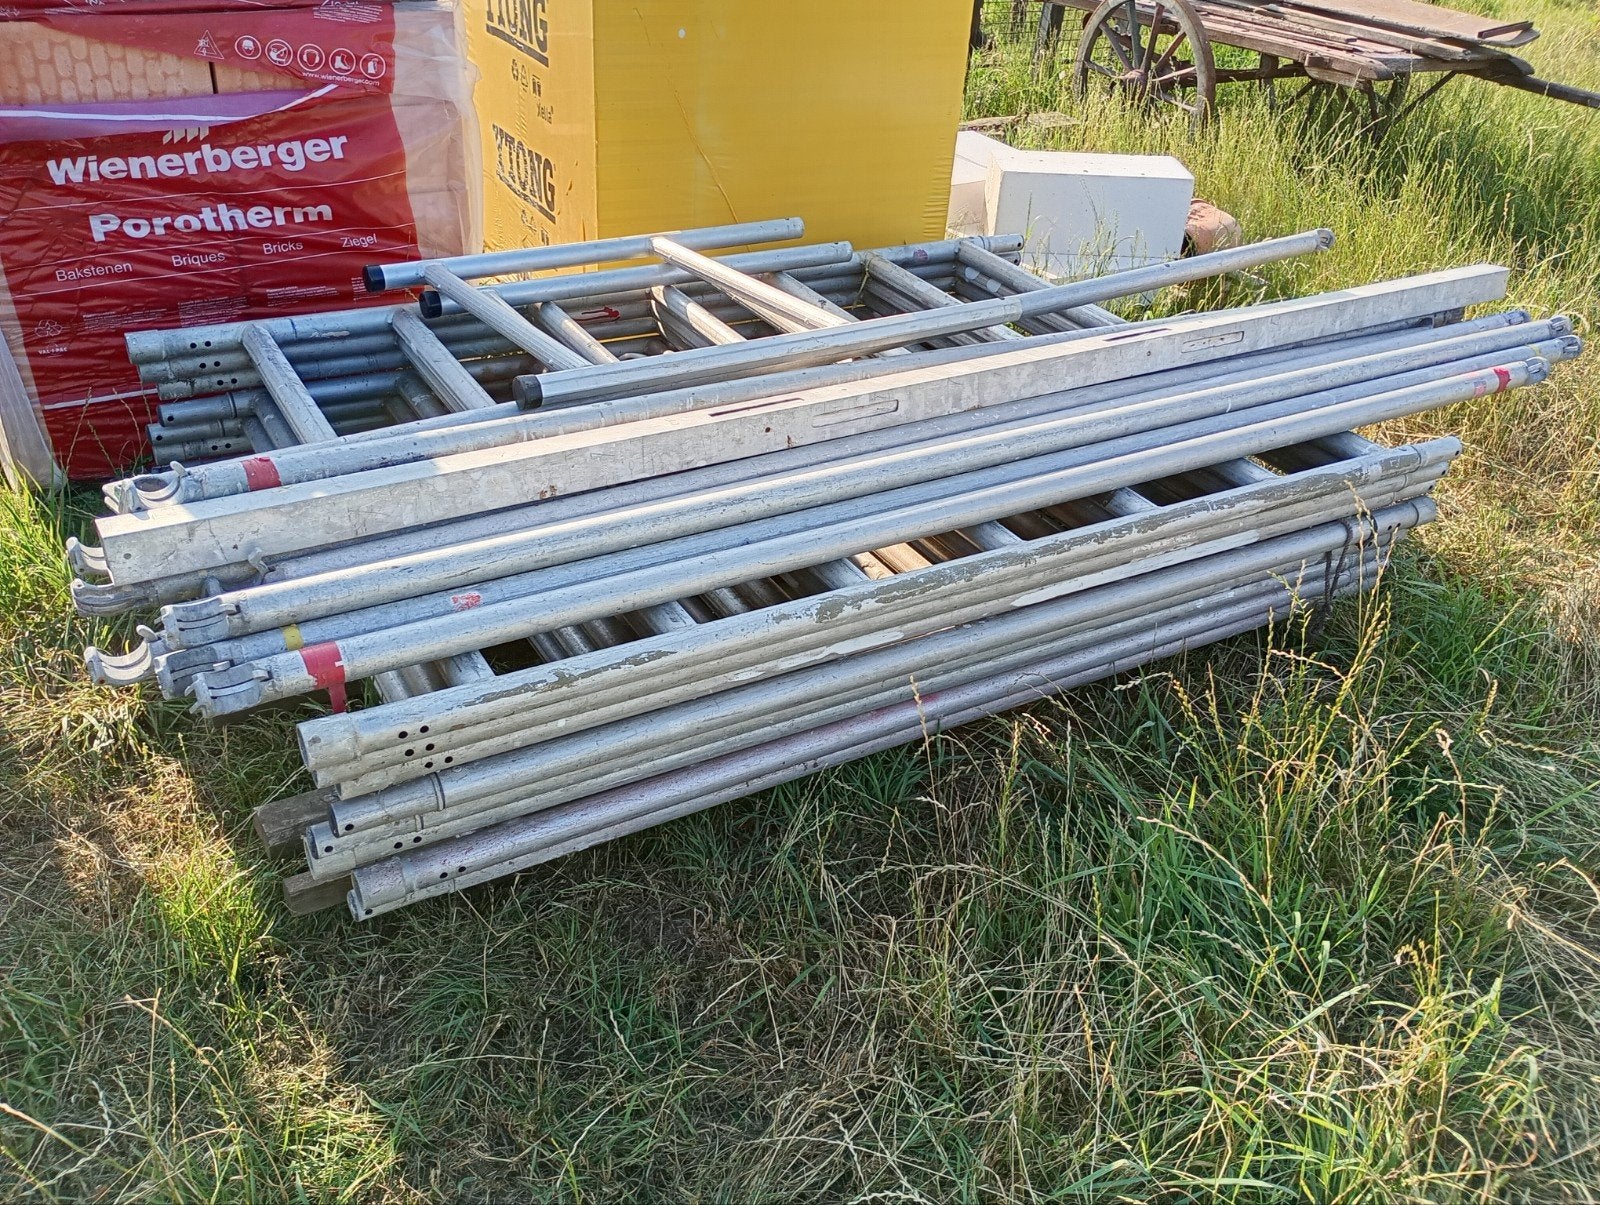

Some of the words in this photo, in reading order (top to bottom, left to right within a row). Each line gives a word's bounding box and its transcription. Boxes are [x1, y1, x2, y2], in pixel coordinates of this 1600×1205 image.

[46, 135, 348, 186] Wienerberger
[492, 123, 555, 212] YTONG
[89, 203, 332, 242] Porotherm
[55, 262, 133, 282] Bakstenen
[171, 252, 226, 268] Briques
[262, 242, 304, 255] Bricks
[340, 233, 378, 249] Ziegel
